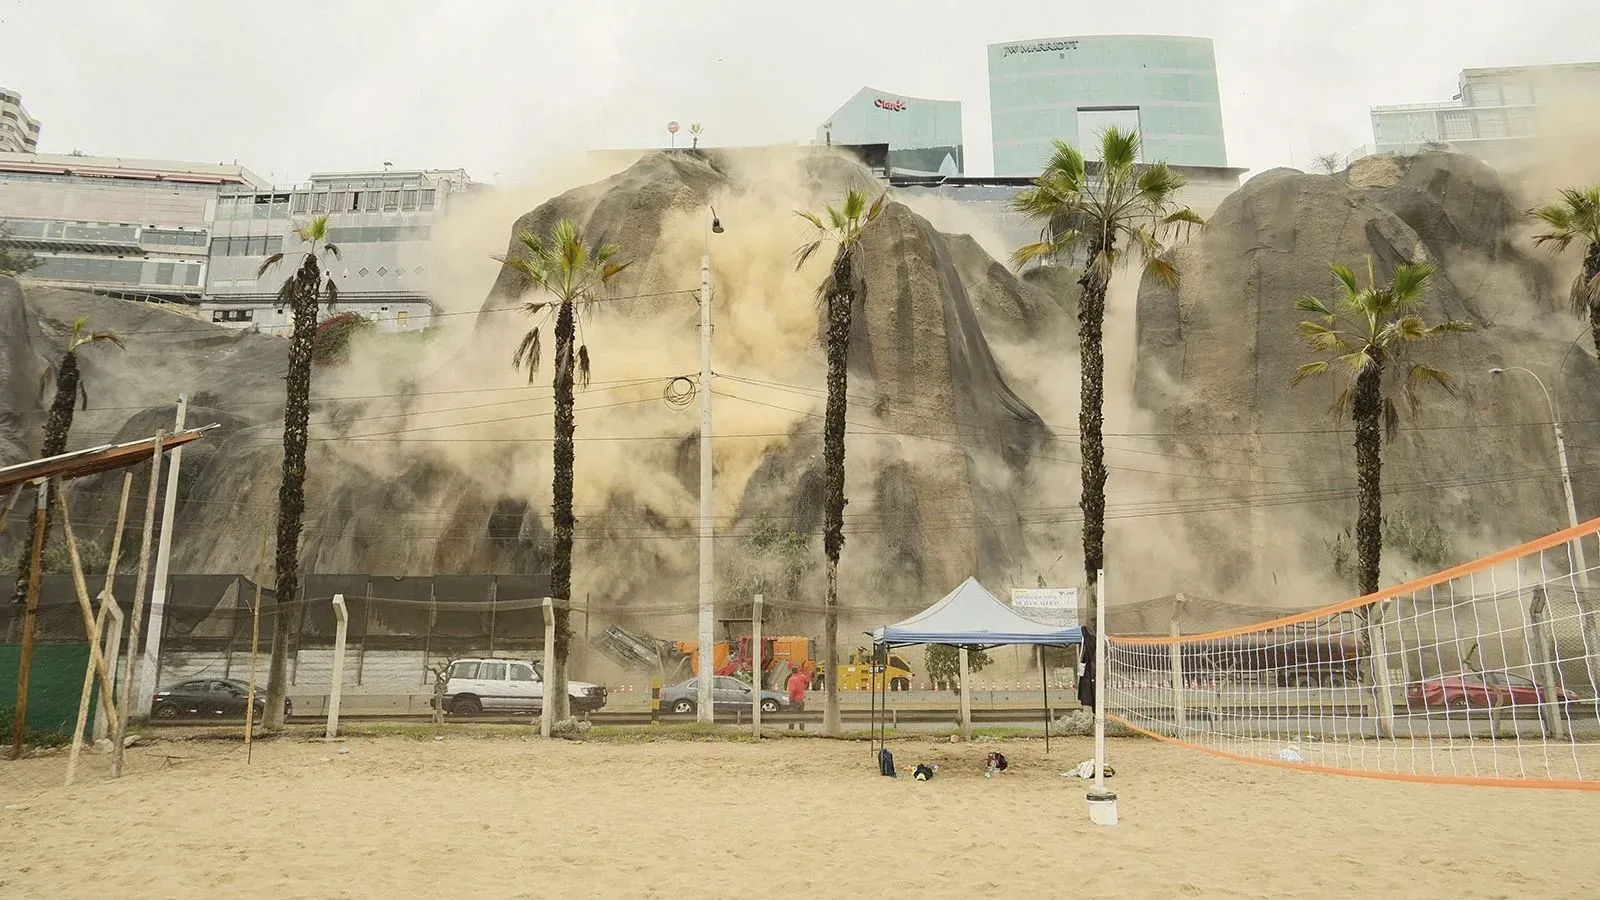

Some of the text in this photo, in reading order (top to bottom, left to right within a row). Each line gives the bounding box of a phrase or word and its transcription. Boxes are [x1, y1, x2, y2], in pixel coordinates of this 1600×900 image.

[1003, 40, 1079, 58] JW MARRIOTT
[874, 98, 906, 112] Claro
